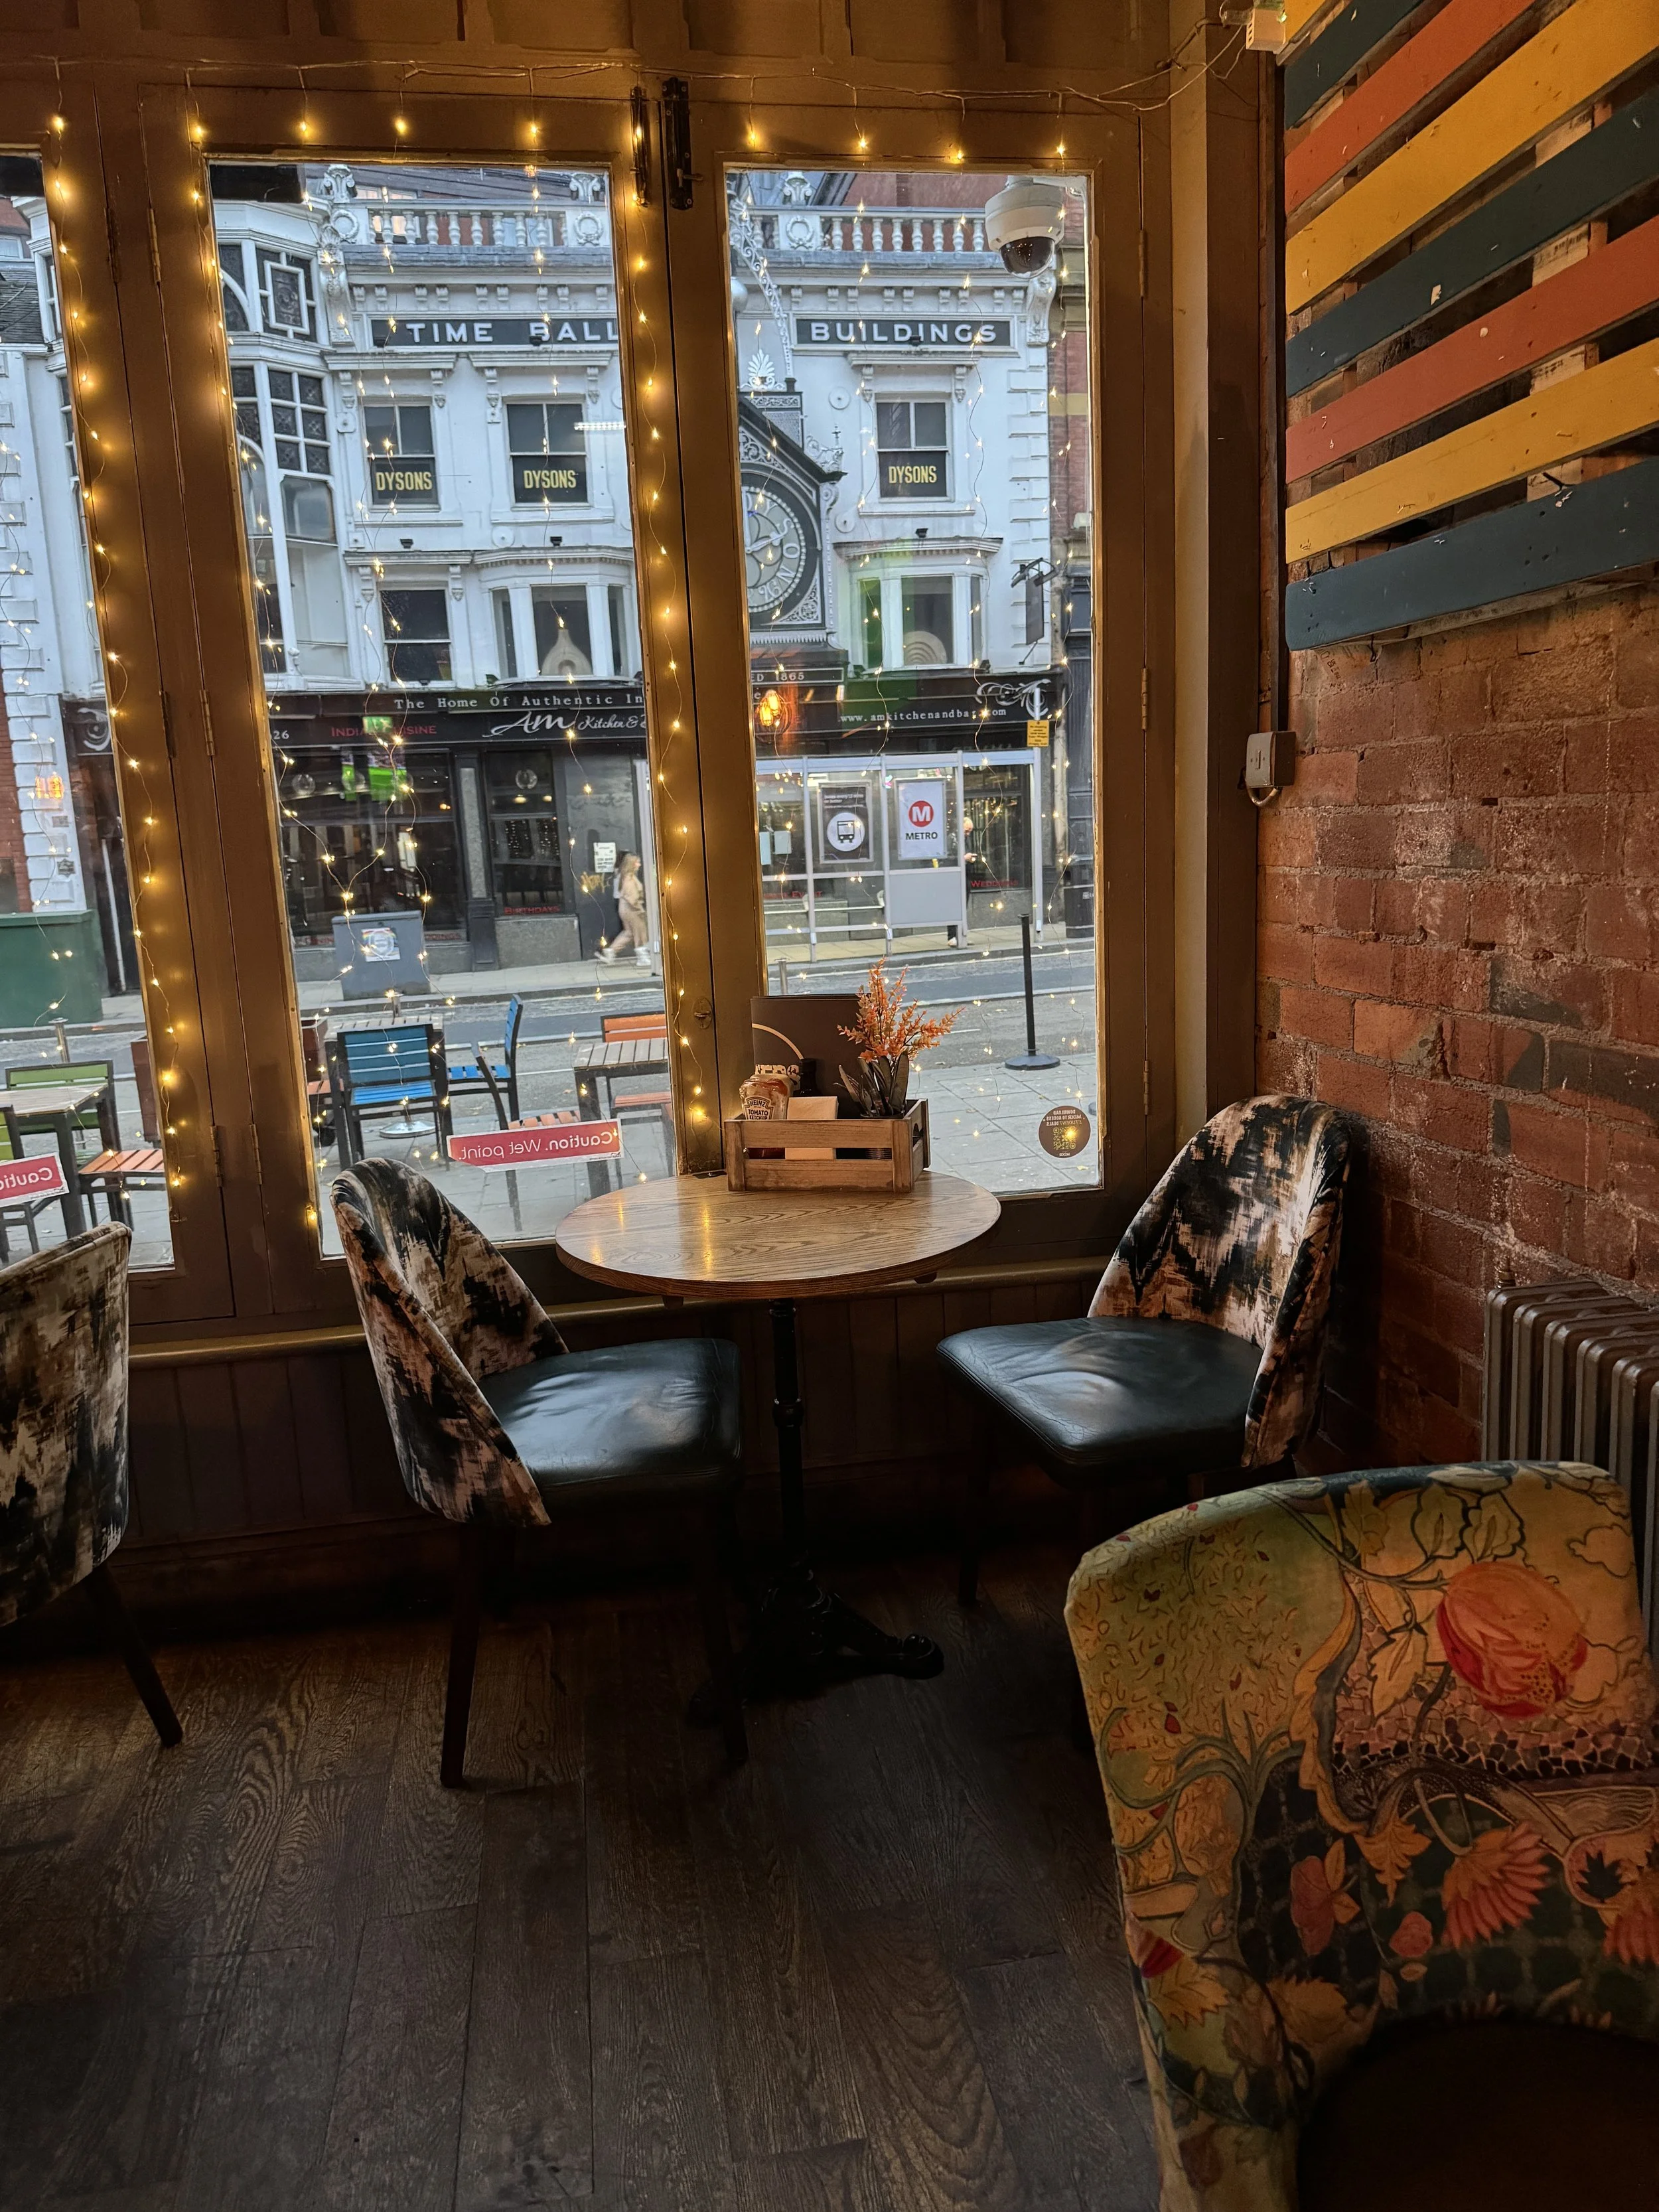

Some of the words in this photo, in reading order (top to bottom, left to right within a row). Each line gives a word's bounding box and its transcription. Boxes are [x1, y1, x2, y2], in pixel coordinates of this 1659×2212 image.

[405, 323, 493, 342] TIME
[529, 321, 618, 342] BALL
[810, 322, 997, 343] BUILDINGS
[375, 471, 432, 491] DYSONS
[523, 469, 577, 489] DYSONS
[888, 465, 938, 484] DYSONS
[775, 672, 805, 682] 1865
[394, 699, 425, 710] The
[437, 698, 478, 708] Home
[490, 696, 510, 707] Of
[522, 694, 613, 707] Authentic
[577, 713, 626, 731] Kitchen
[272, 730, 290, 740] 26
[331, 727, 372, 737] INDIA
[912, 806, 930, 822] M
[905, 832, 938, 840] METRO
[504, 906, 561, 915] BIRTHDAYS
